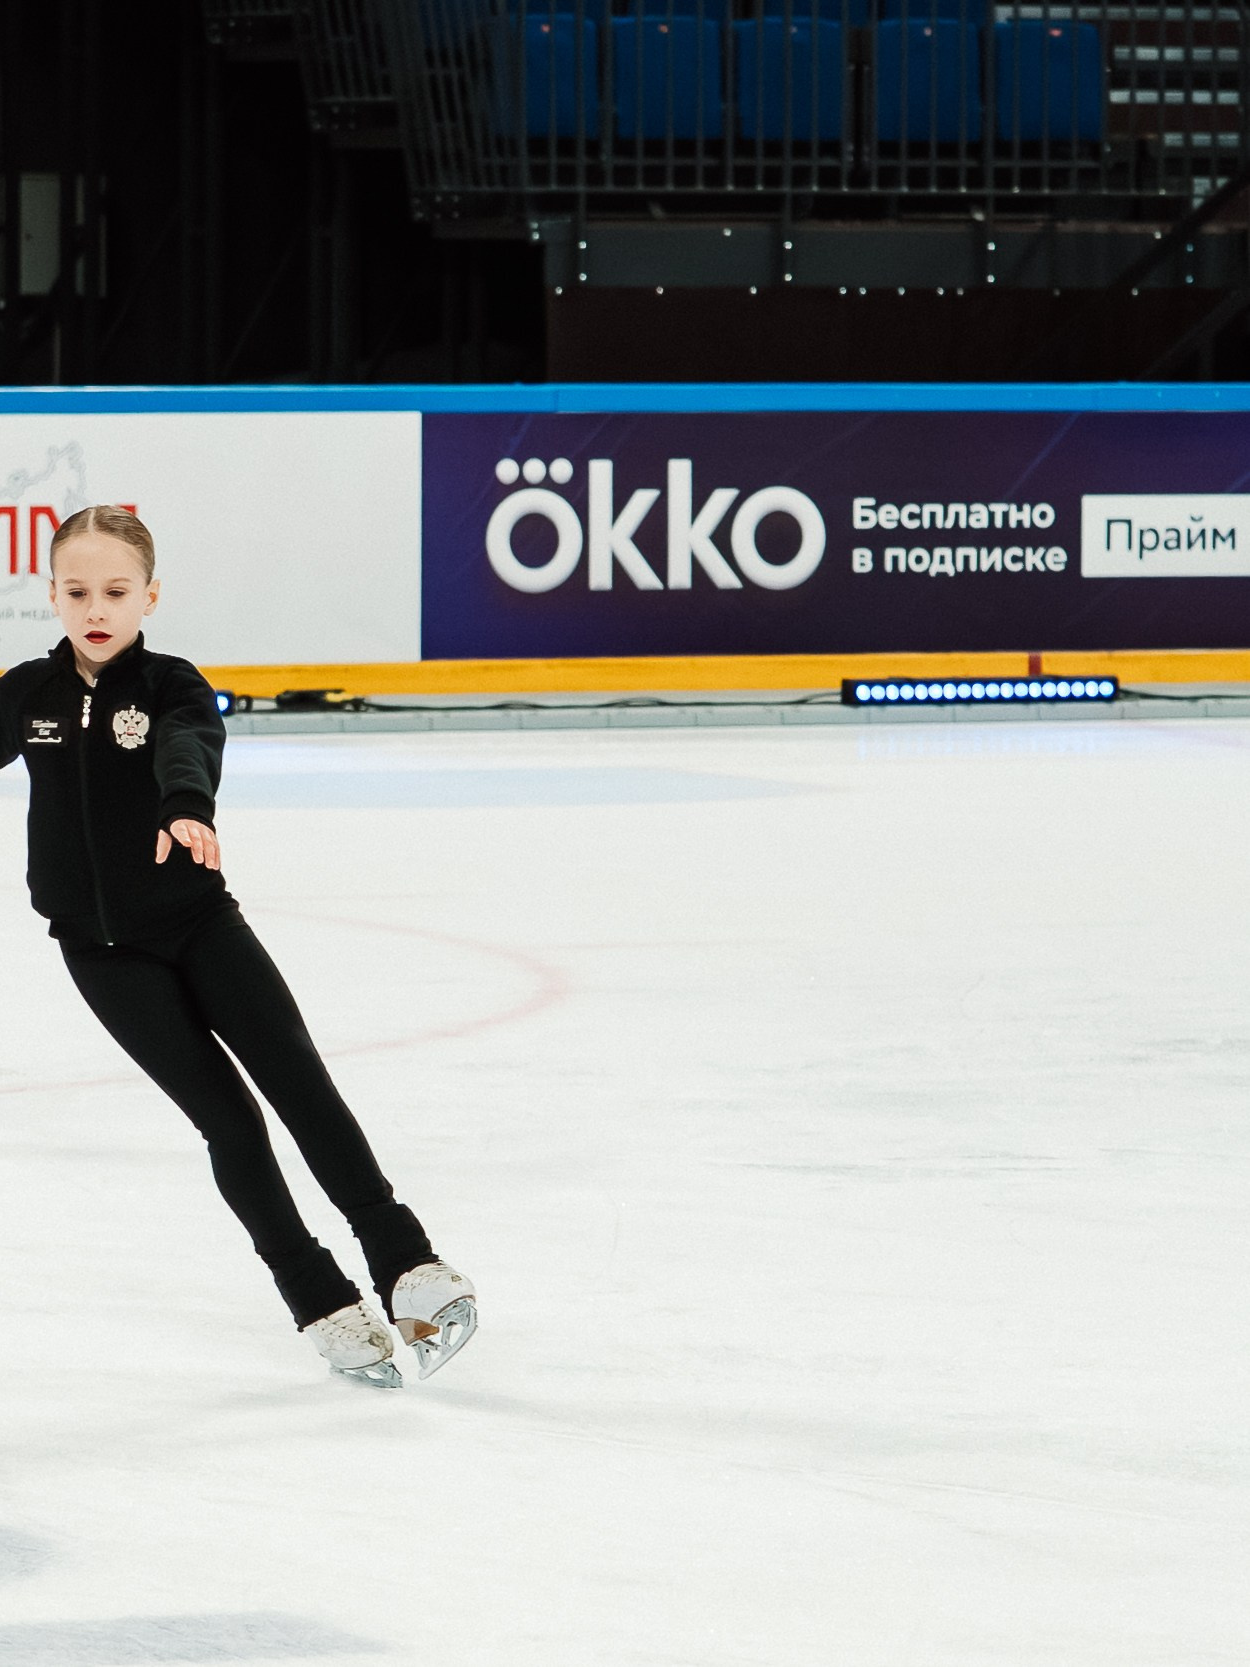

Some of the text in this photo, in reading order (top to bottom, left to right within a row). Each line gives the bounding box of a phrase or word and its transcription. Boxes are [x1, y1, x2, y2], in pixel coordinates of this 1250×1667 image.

[852, 497, 1056, 531] Бесплатно
[1106, 516, 1237, 561] Прайм
[852, 546, 1069, 578] в подписке
